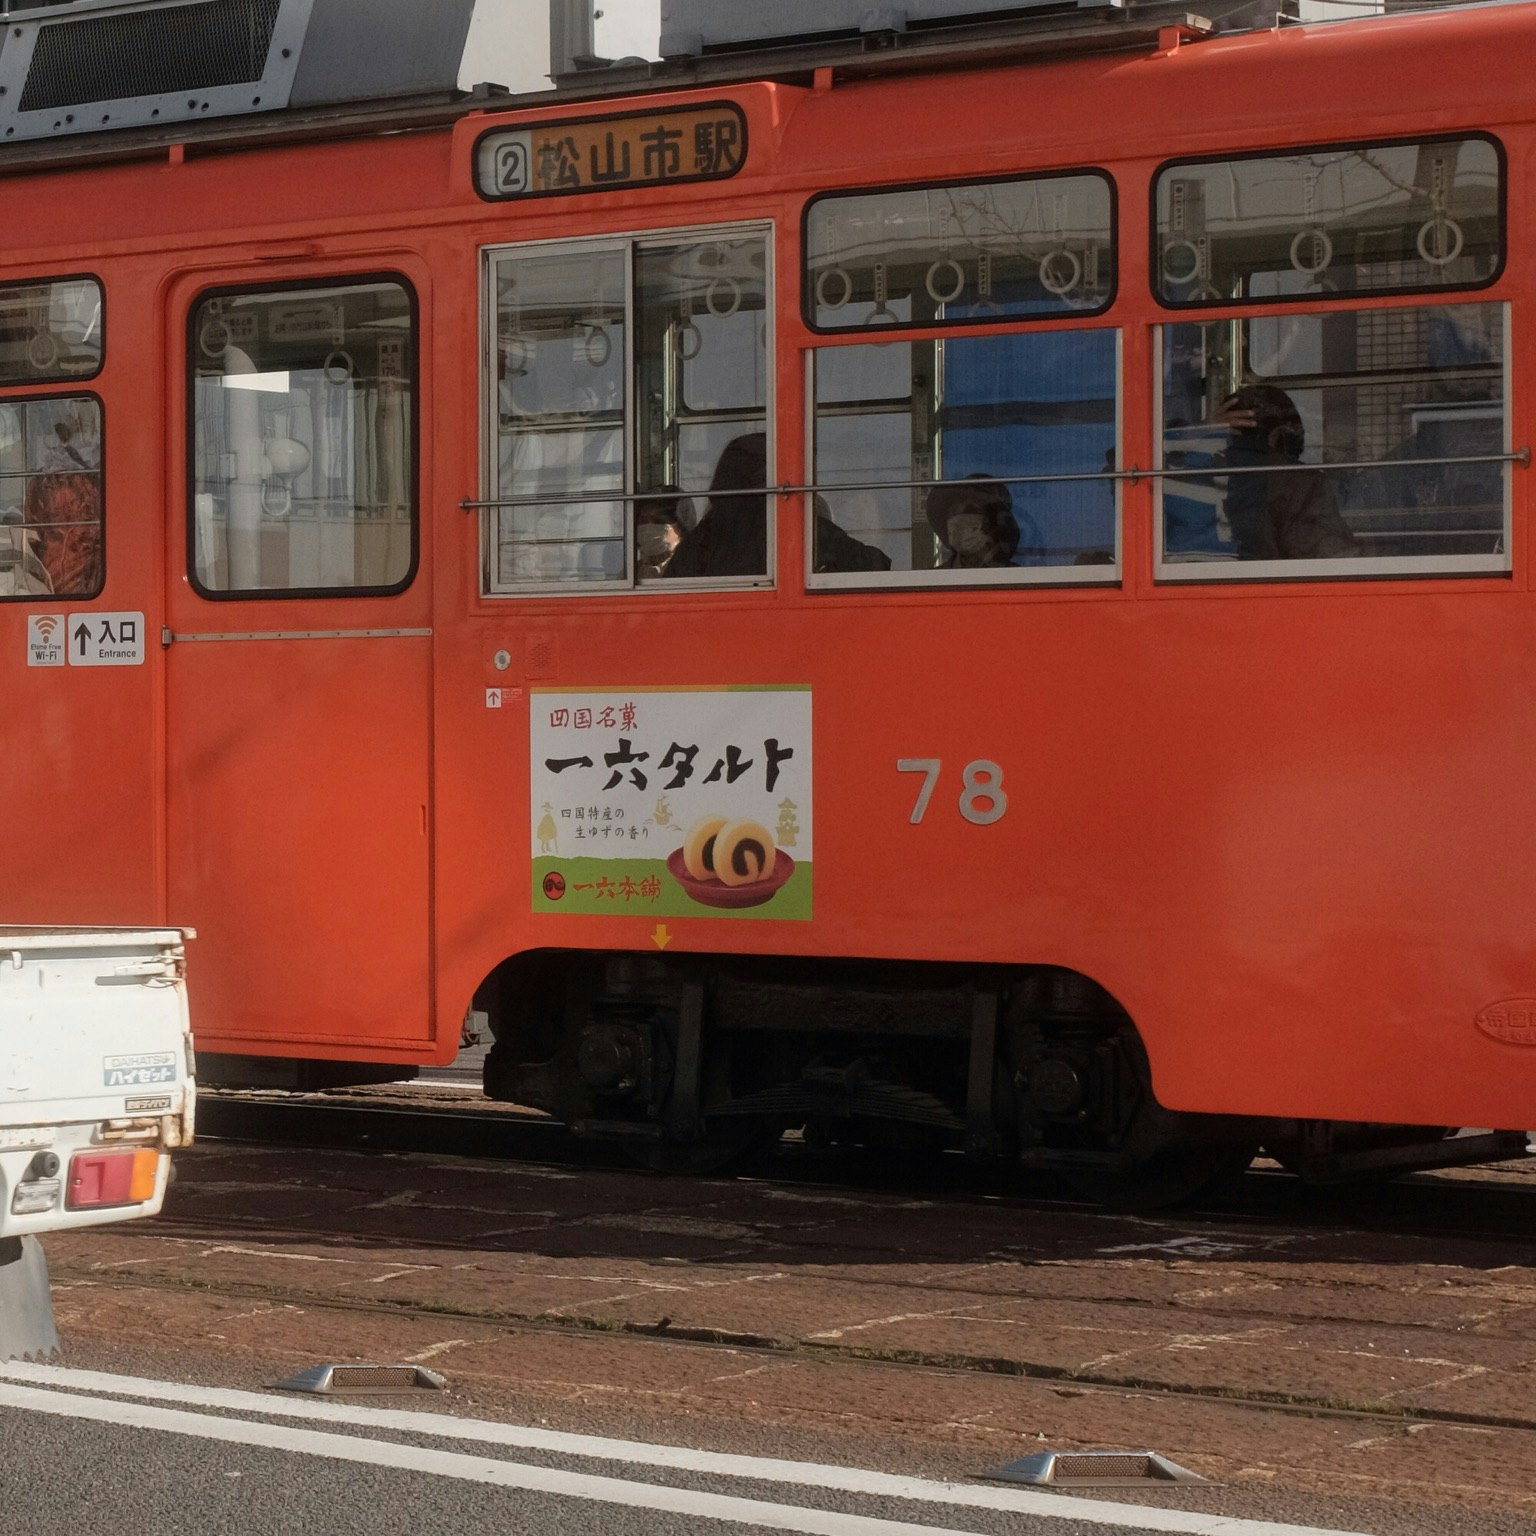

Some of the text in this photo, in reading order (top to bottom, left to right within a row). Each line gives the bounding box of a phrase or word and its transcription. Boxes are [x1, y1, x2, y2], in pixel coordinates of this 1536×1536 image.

[500, 119, 739, 187] 2 松山市駅
[98, 620, 136, 644] 入口
[35, 651, 57, 661] Wi-Fi
[98, 649, 136, 658] Entrance
[549, 702, 639, 733] 四国名菓
[544, 737, 795, 793] 一六タルト
[895, 758, 1009, 825] 78
[560, 805, 625, 821] 四国特産の
[574, 824, 651, 841] 生ゆずの香り
[572, 875, 662, 902] 一六本舗
